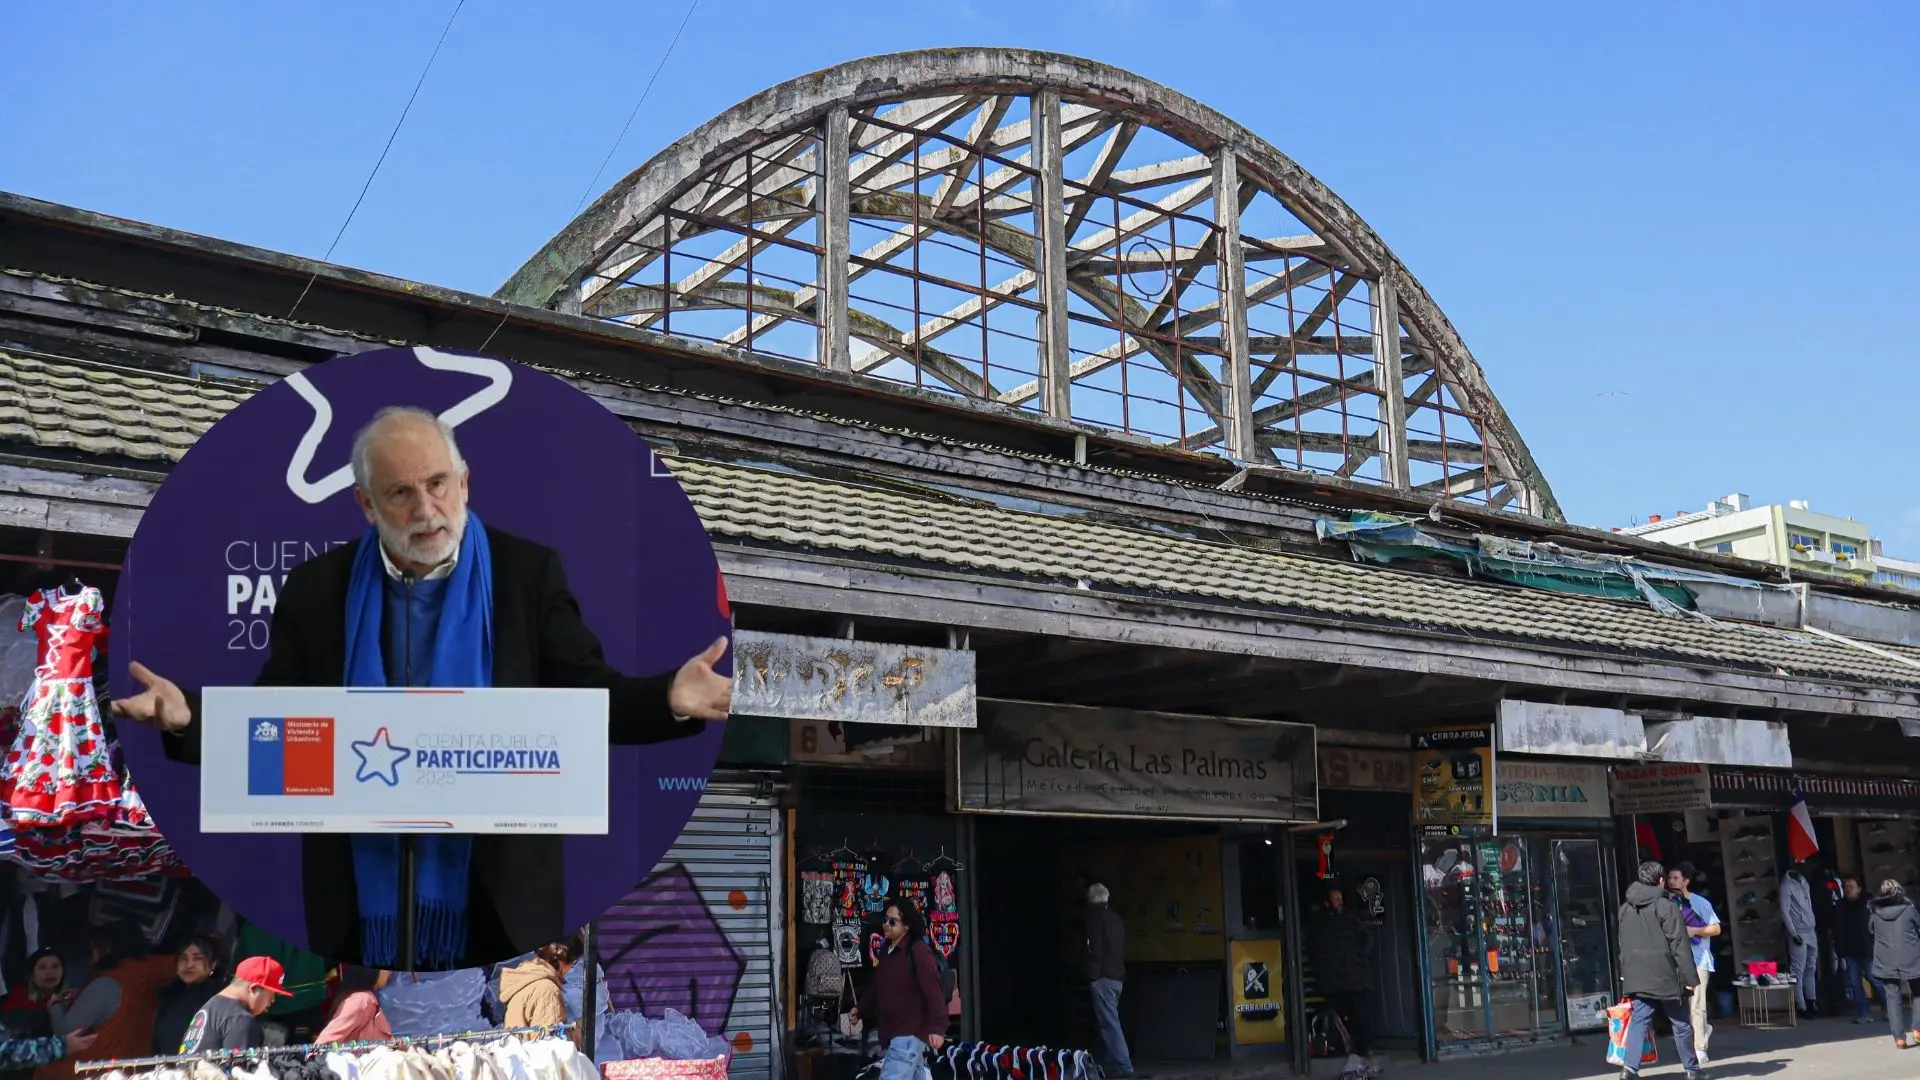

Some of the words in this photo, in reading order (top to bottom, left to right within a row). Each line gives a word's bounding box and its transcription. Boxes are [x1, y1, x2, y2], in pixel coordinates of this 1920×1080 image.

[225, 540, 349, 571] CUEN
[228, 574, 289, 615] PA
[415, 733, 485, 748] CUENTA
[490, 730, 559, 748] PÚBLICA
[1432, 730, 1485, 740] CERRAJERIA
[416, 749, 561, 769] PARTICIPATIVA
[1025, 738, 1119, 772] Galería
[1130, 745, 1172, 775] Las
[1182, 749, 1267, 780] Palmas
[416, 769, 456, 786] 2025
[1616, 767, 1657, 780] BAZAR
[1661, 763, 1702, 777] SONIA
